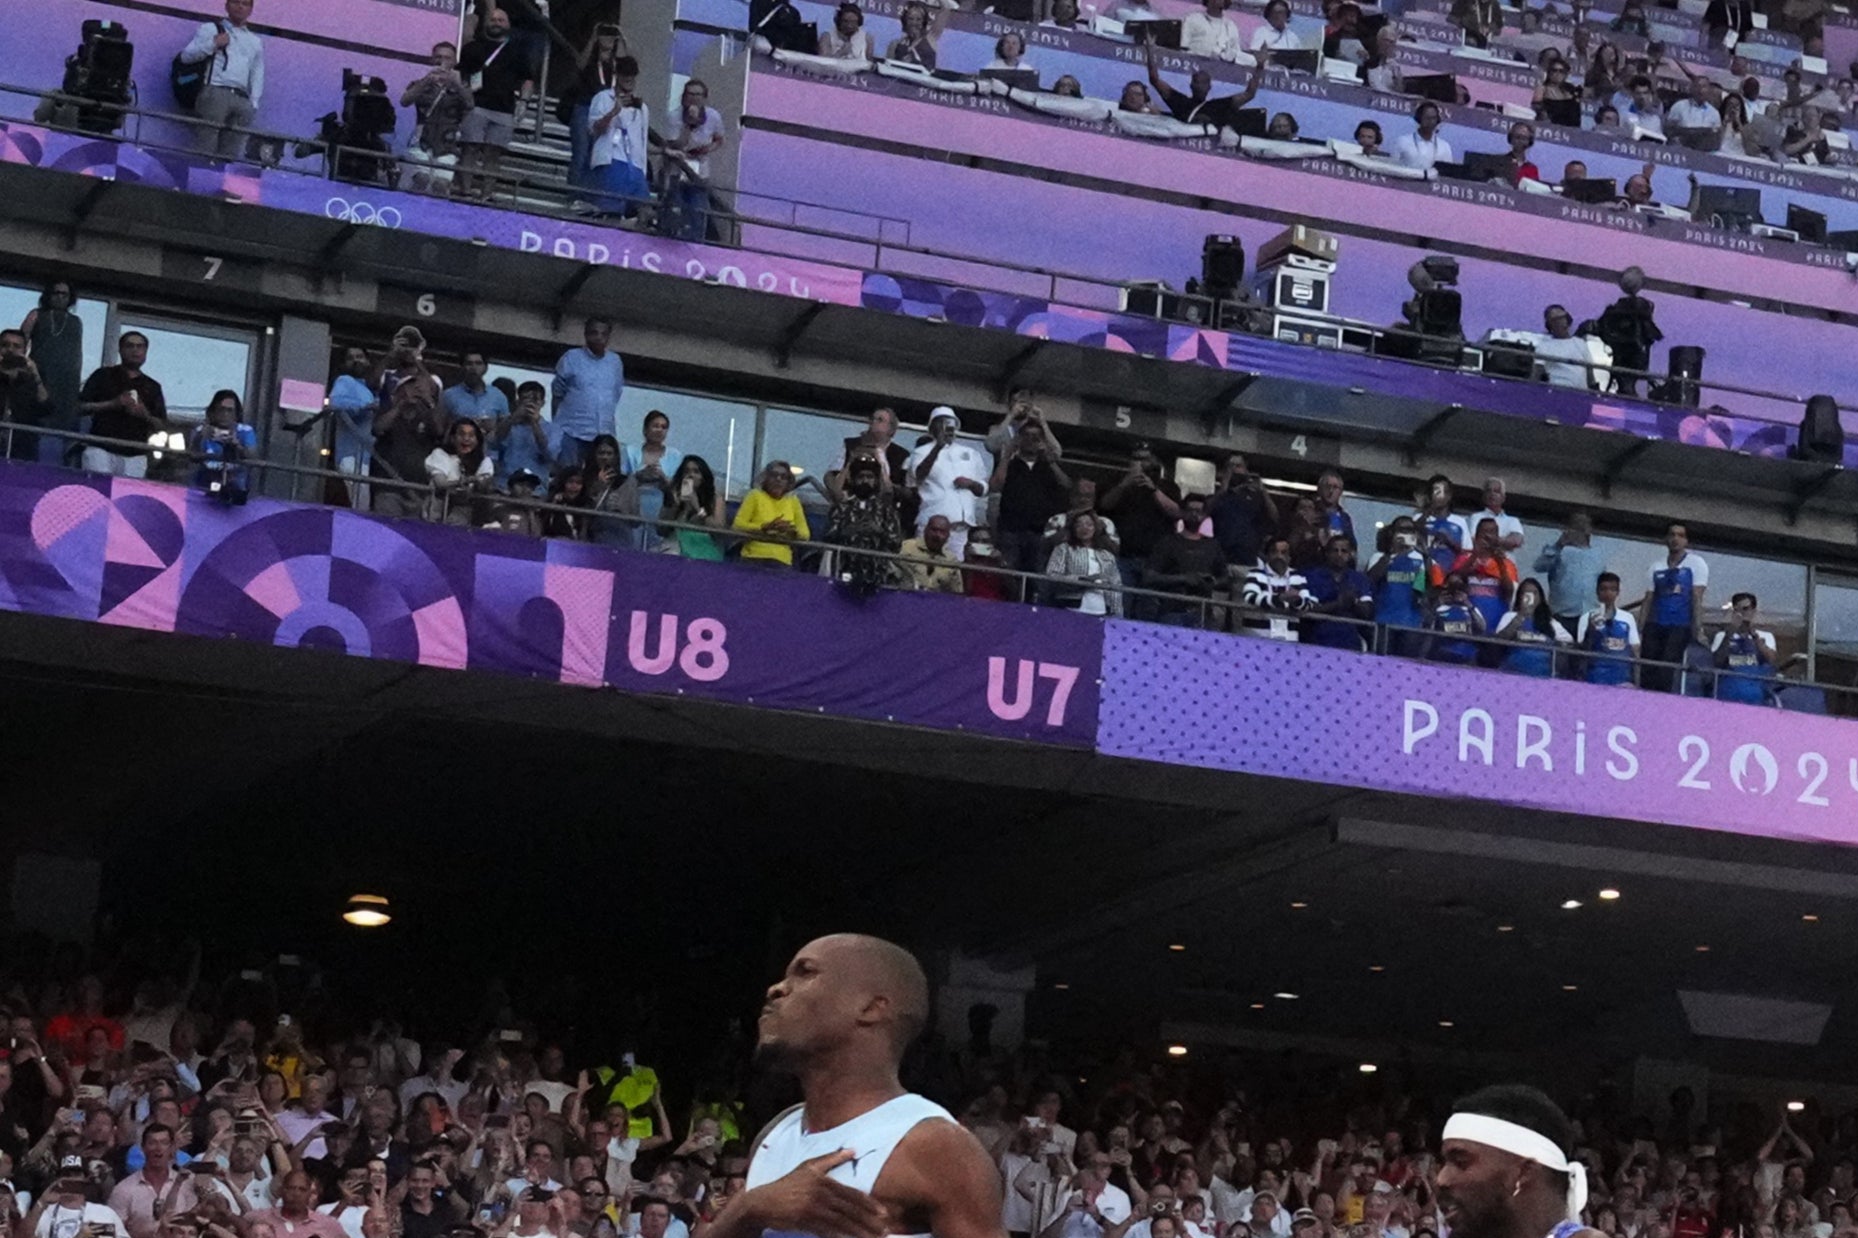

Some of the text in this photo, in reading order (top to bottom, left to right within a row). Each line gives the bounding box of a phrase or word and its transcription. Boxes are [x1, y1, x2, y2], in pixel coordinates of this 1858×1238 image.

[203, 257, 222, 281] 7
[416, 293, 436, 317] 6
[1114, 407, 1131, 429] 5
[1289, 434, 1307, 458] 4
[628, 610, 730, 682] U8
[987, 656, 1081, 727] U7
